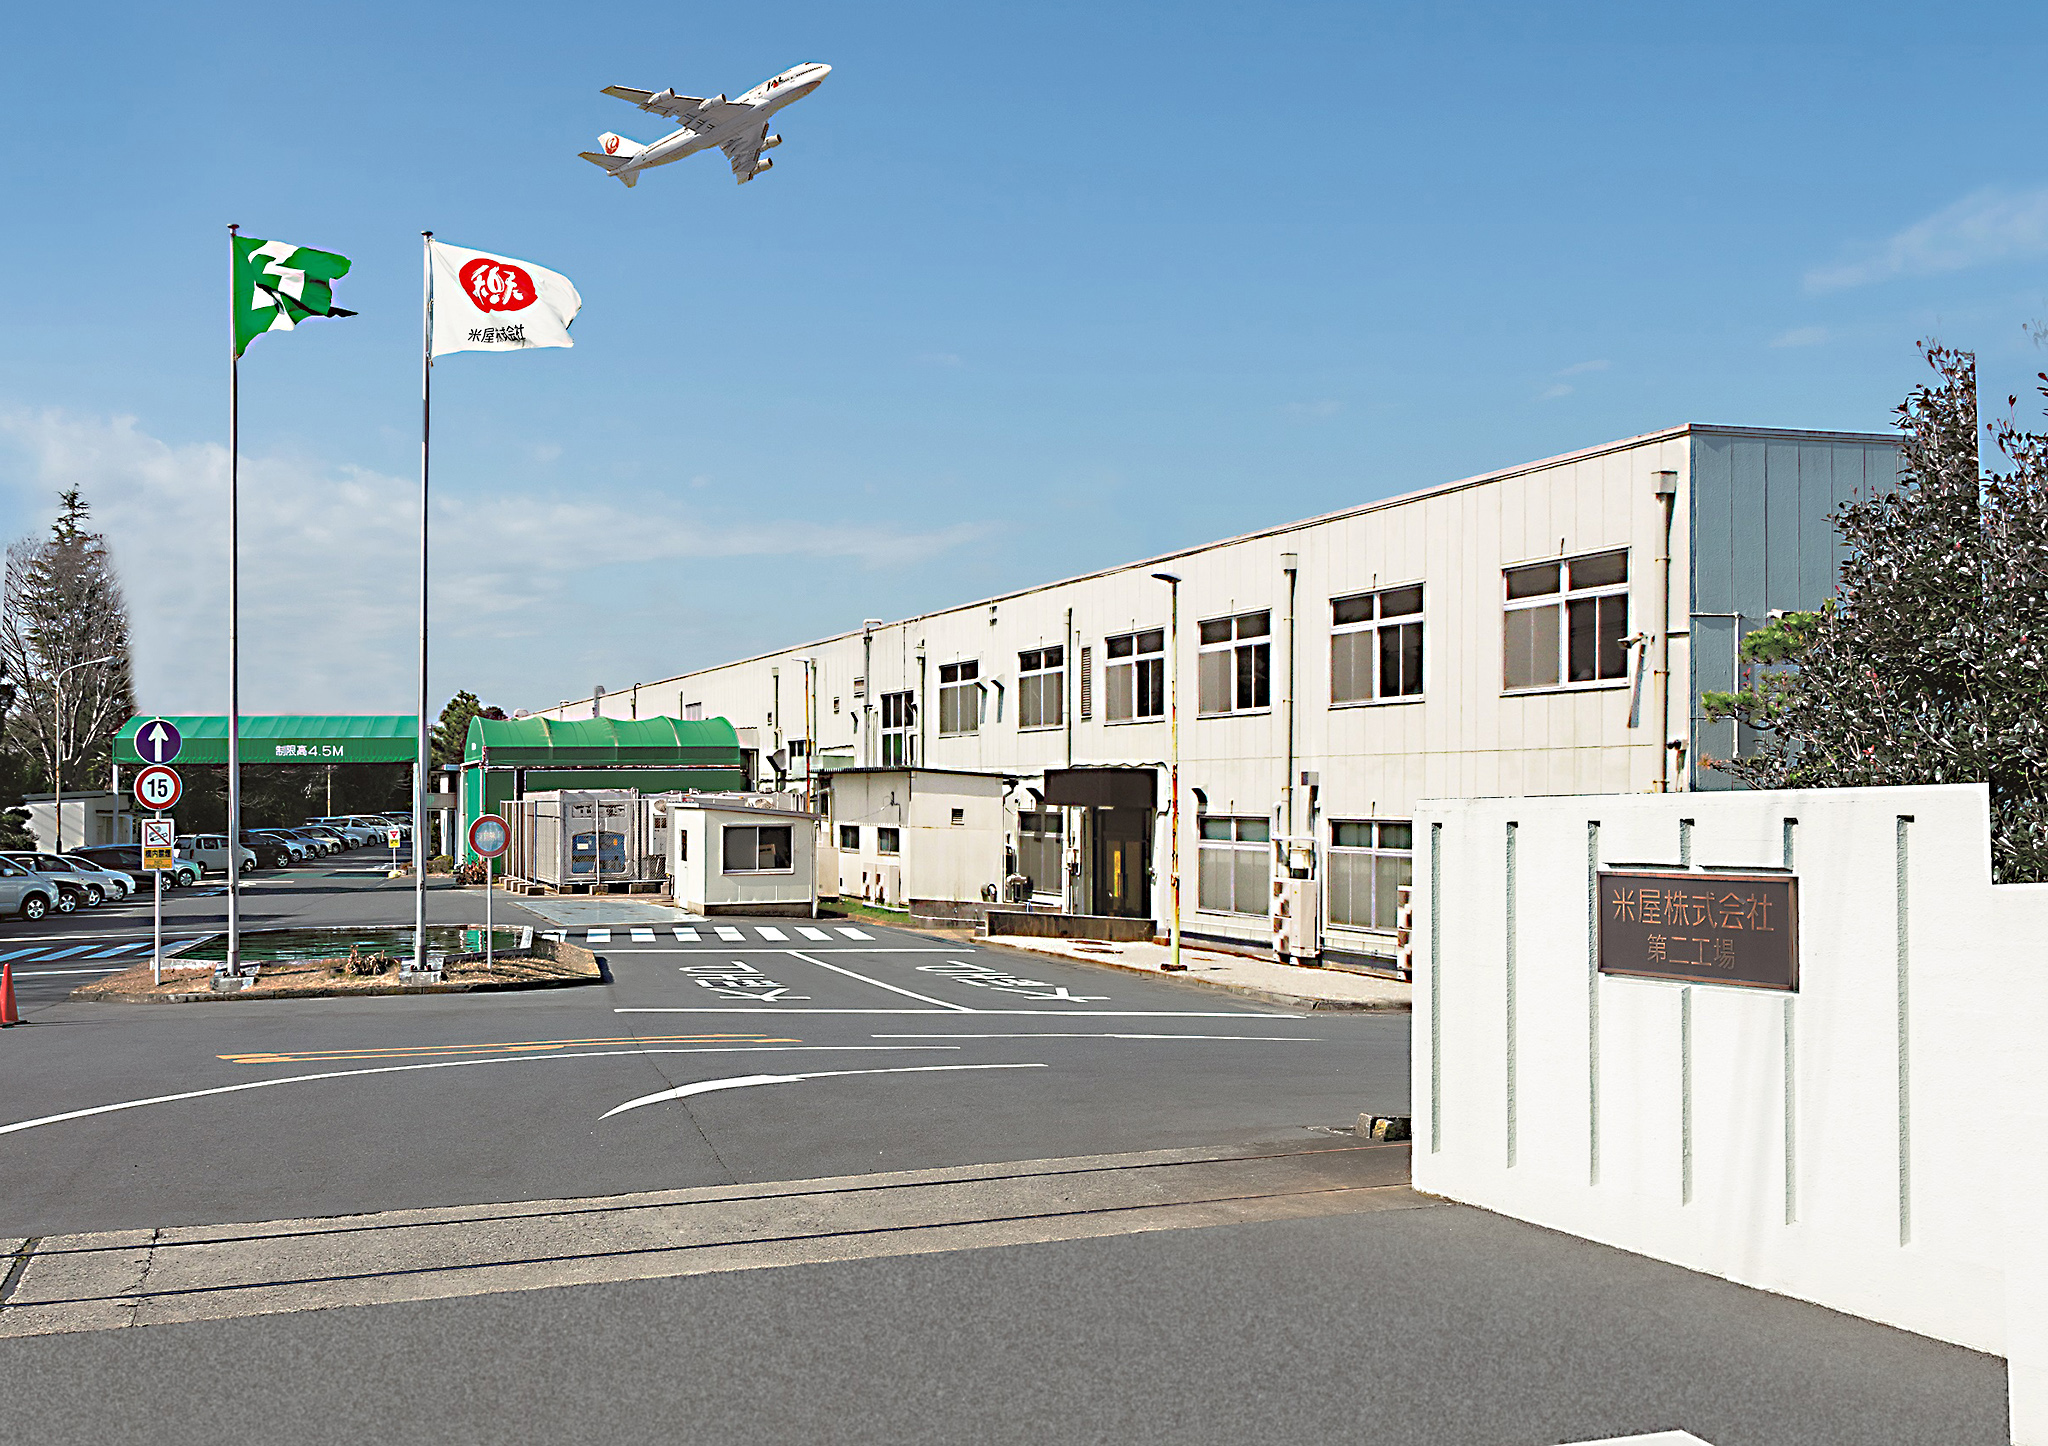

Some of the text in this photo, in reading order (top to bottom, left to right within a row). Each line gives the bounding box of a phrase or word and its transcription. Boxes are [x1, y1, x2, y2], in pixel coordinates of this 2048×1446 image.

[766, 76, 783, 92] JAL
[147, 778, 168, 798] 15
[1612, 887, 1774, 931] 米屋株式会社
[1647, 933, 1736, 970] 第二工場
